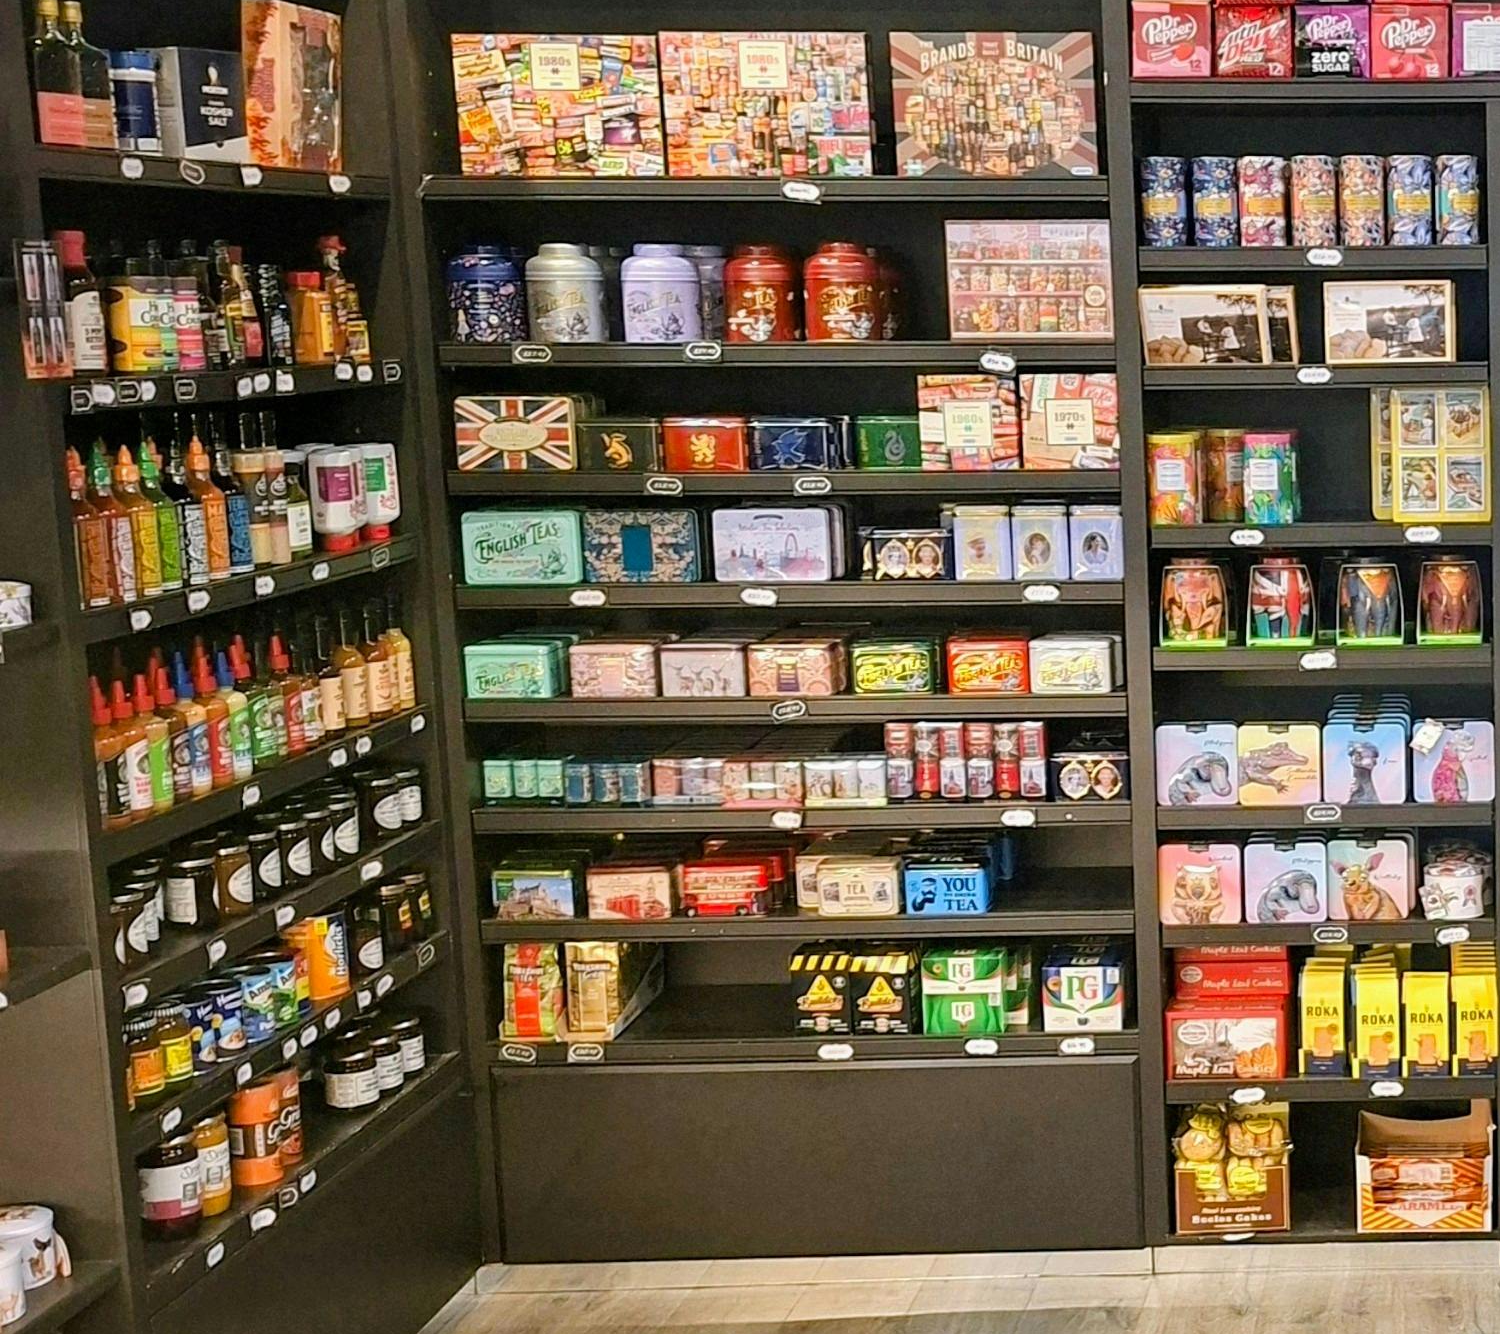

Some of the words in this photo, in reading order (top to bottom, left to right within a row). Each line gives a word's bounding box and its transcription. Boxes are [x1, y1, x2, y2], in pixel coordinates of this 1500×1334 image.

[538, 56, 572, 67] 1980s
[920, 43, 976, 72] BRANDS
[1006, 40, 1063, 72] BRITAIN
[1312, 62, 1349, 72] SUGAR
[1054, 411, 1086, 423] 1970s
[474, 533, 527, 561] ENGLISH
[531, 523, 560, 548] TEAS
[847, 884, 865, 895] TEA
[942, 877, 976, 891] YOU
[943, 899, 978, 912] TEA
[335, 922, 344, 978] Horlicks
[951, 961, 972, 976] PG
[1065, 976, 1098, 999] PG
[1203, 979, 1230, 989] Maple
[1231, 979, 1250, 988] Leaf
[1252, 979, 1282, 988] Cookies
[1306, 1006, 1339, 1017] ROKA
[1460, 1010, 1493, 1022] ROKA
[1361, 1014, 1395, 1025] ROKA
[1410, 1012, 1443, 1024] ROKA
[1176, 1064, 1209, 1076] Maple
[1212, 1064, 1234, 1075] Leaf
[1236, 1064, 1273, 1075] Cookies
[1192, 1214, 1231, 1224] Eccles
[1234, 1213, 1272, 1223] Cakes
